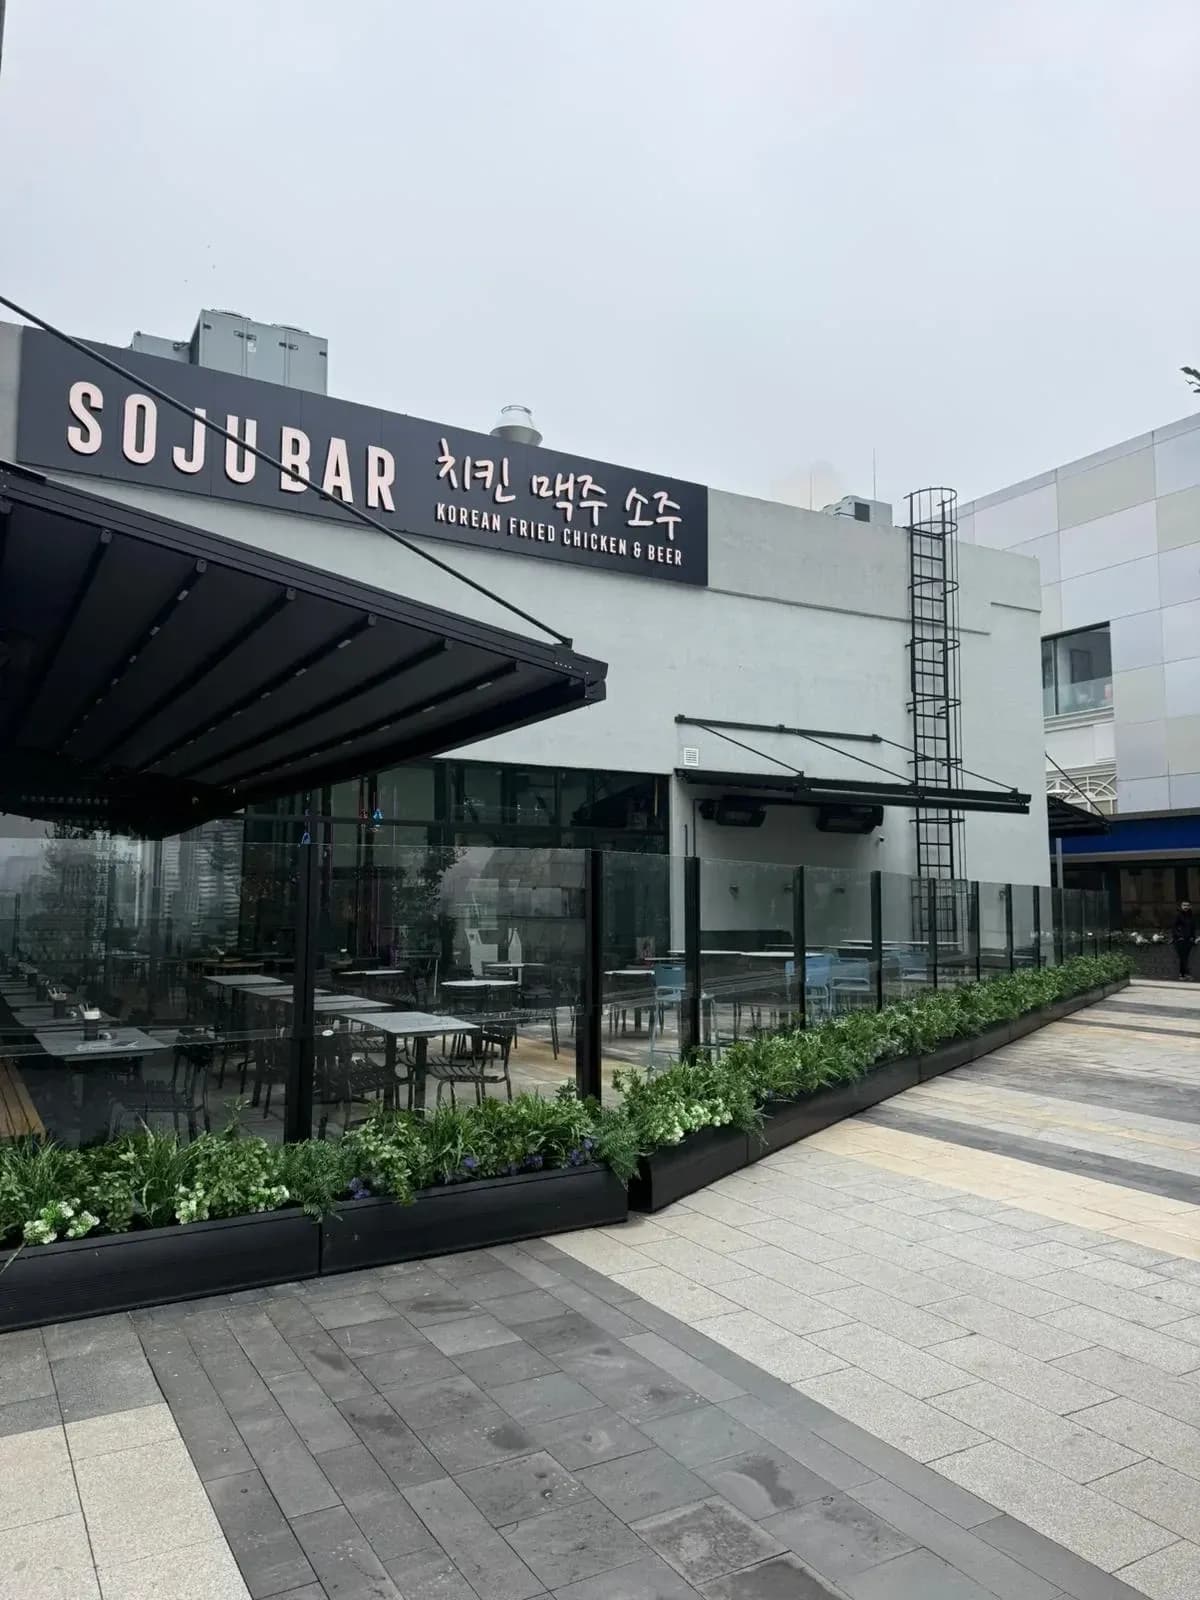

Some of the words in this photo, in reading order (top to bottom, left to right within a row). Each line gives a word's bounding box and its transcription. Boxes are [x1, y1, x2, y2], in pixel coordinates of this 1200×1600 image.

[437, 438, 516, 502] 치킨
[531, 473, 608, 526] 맥주
[625, 487, 682, 540] 소주
[436, 503, 501, 531] KOREAN
[509, 517, 556, 542] FRIED
[563, 528, 627, 555] CHICKEN
[633, 542, 642, 558] &
[648, 545, 682, 566] BEER
